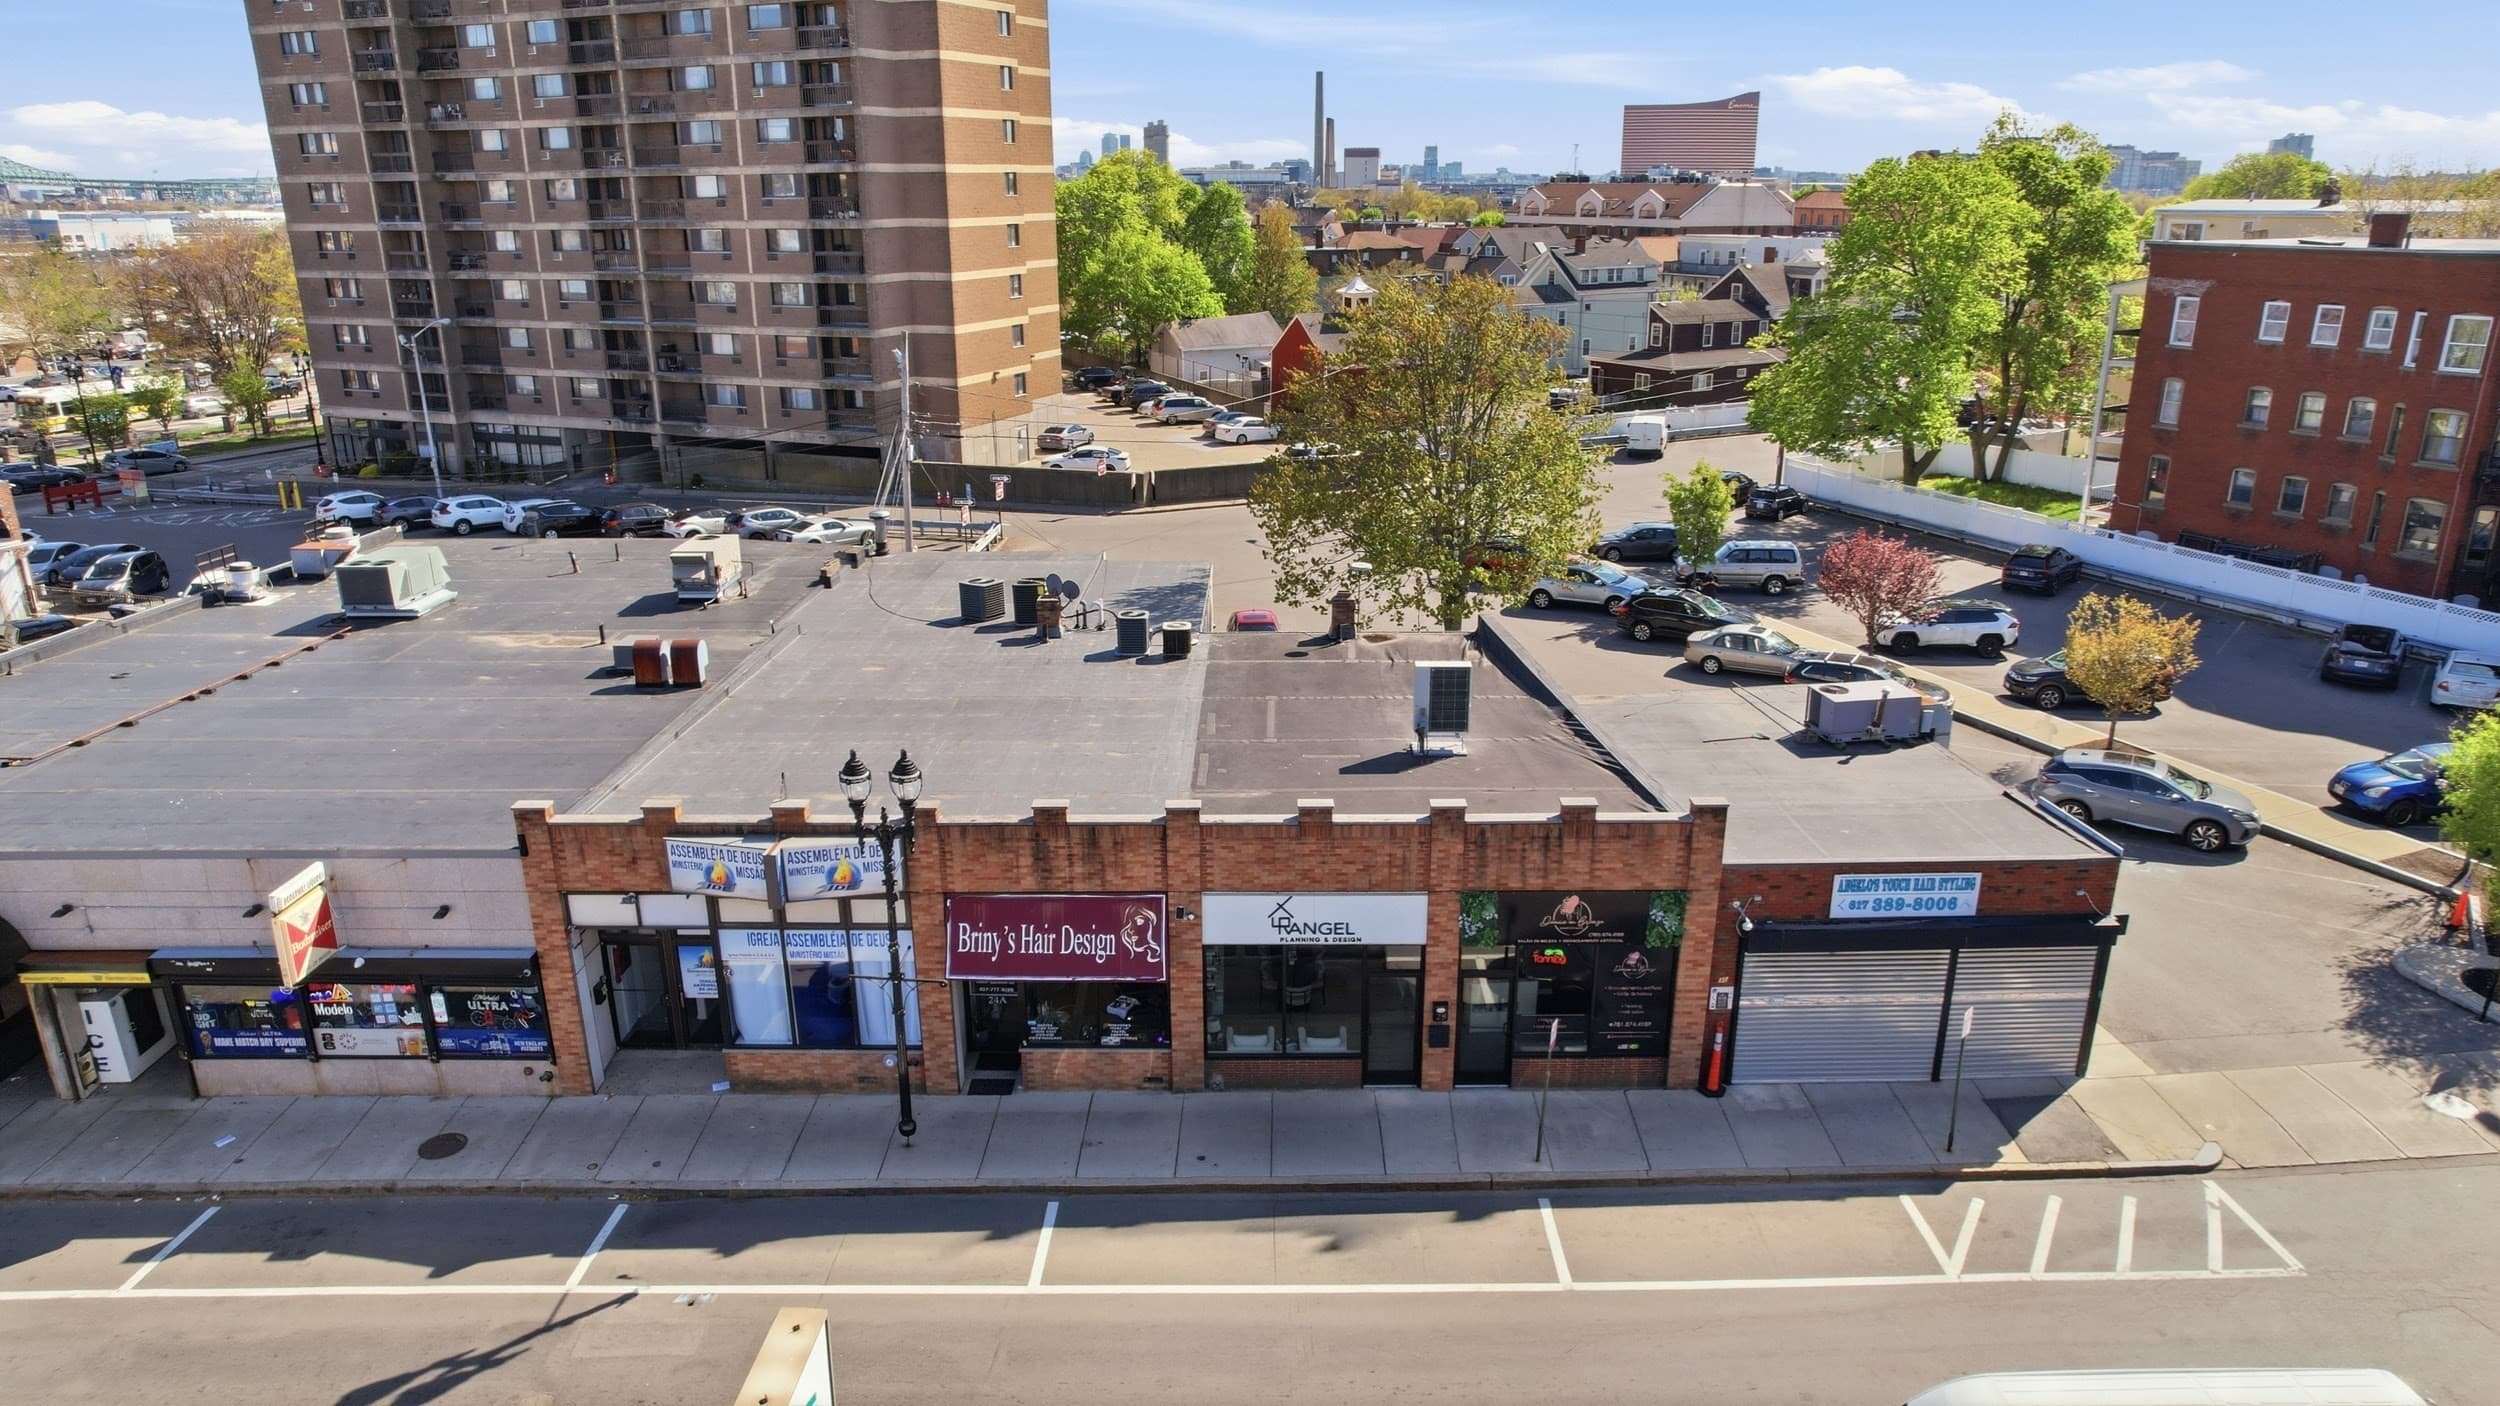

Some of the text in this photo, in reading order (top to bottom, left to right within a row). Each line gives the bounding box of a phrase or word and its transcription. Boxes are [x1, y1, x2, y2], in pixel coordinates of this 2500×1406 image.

[727, 850, 738, 863] DE
[741, 851, 764, 865] DEUS
[672, 861, 766, 880] MINISTÉRIO MISSÃO
[788, 866, 825, 876] MINISTÉRIO
[1882, 877, 1911, 891] TOUCH
[1913, 877, 1936, 891] HAIR
[1938, 876, 1976, 890] STYLING
[1848, 900, 1869, 910] 617
[291, 919, 333, 954] Budweiser
[747, 932, 780, 946] IGREJA
[786, 931, 847, 948] ASSEMBLÉIA
[852, 933, 864, 947] DE
[1020, 924, 1055, 954] Hair
[1060, 924, 1116, 963] Design
[313, 1003, 353, 1016] Modelo
[467, 1000, 509, 1011] ULTRA
